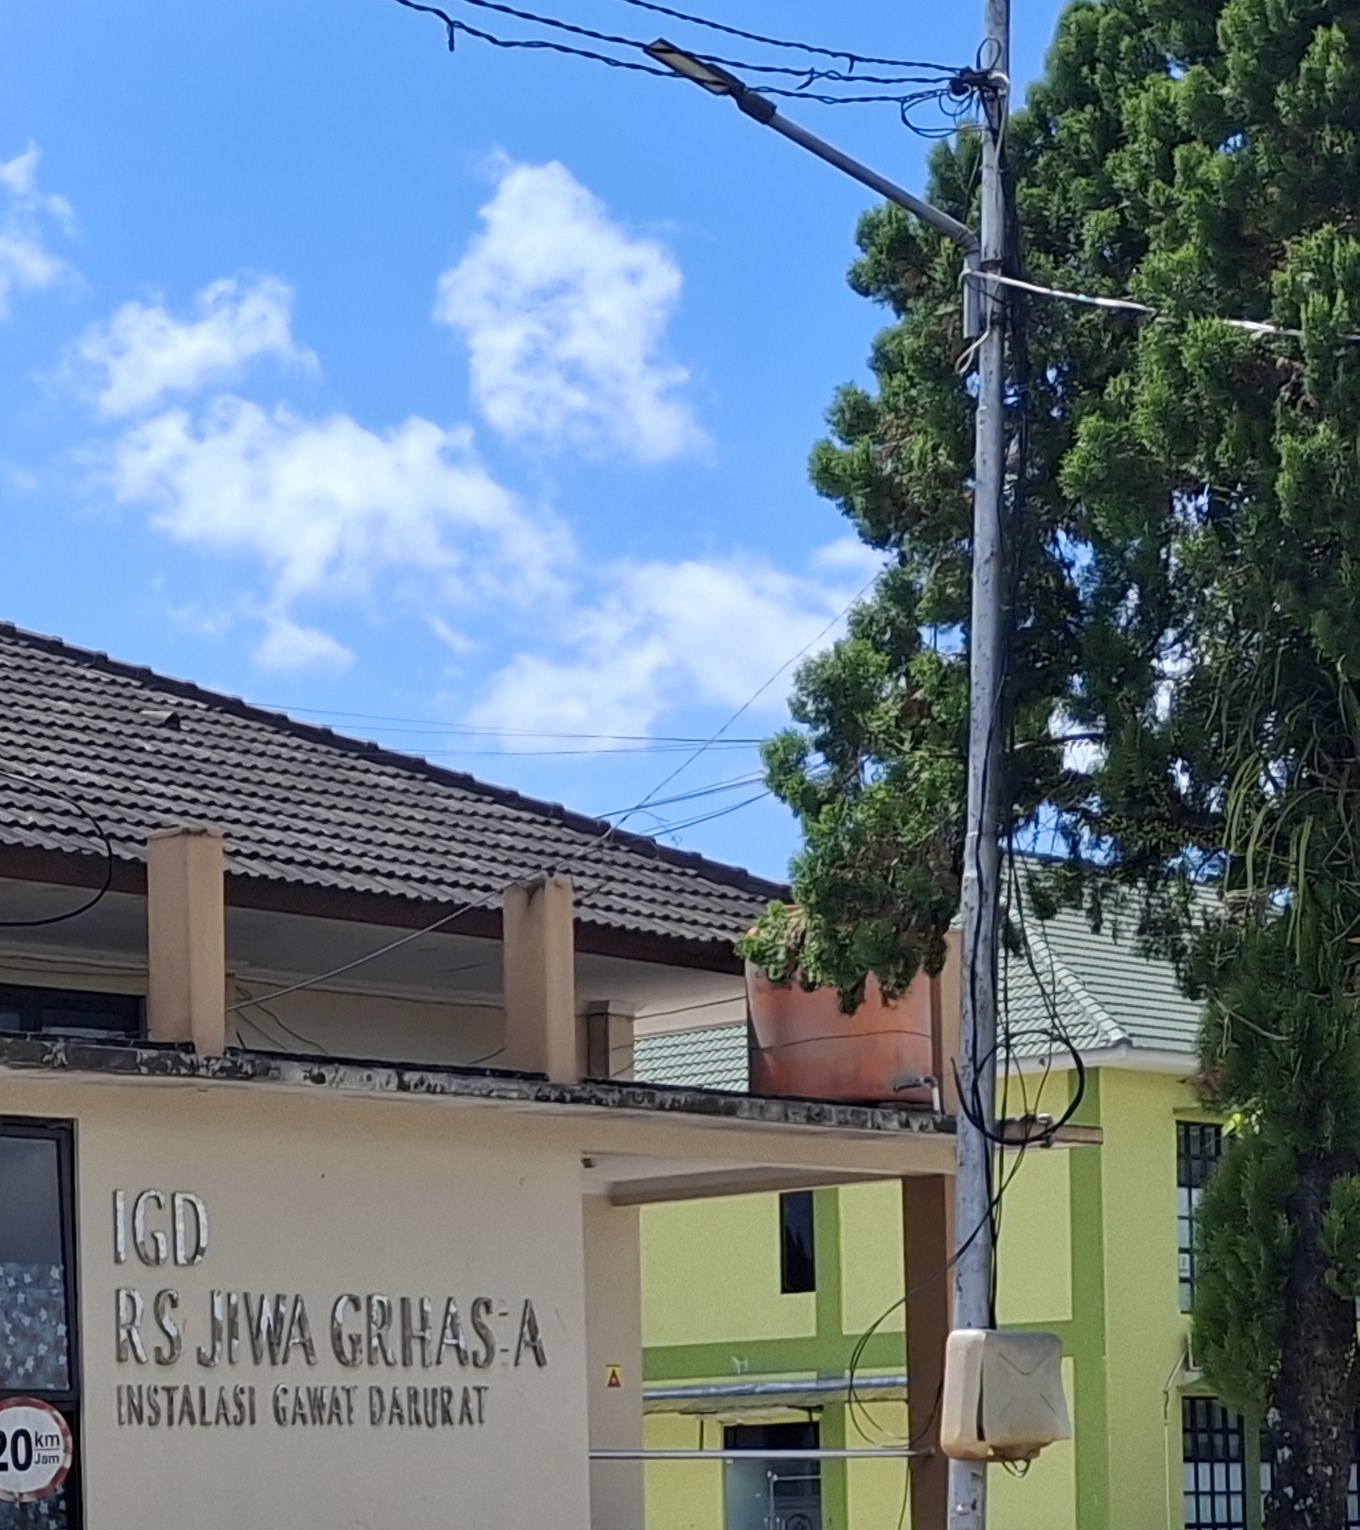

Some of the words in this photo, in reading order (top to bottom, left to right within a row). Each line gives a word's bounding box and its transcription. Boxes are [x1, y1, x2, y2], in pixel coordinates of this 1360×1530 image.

[113, 1188, 209, 1267] IGD
[116, 1287, 182, 1367] RS
[196, 1288, 317, 1368] JIWA
[331, 1293, 548, 1369] GRHASA
[117, 1384, 257, 1427] INSTALASI
[272, 1384, 359, 1427] GAWAT
[368, 1385, 489, 1428] DARURAT
[34, 1453, 60, 1465] Jam
[35, 1431, 60, 1447] km
